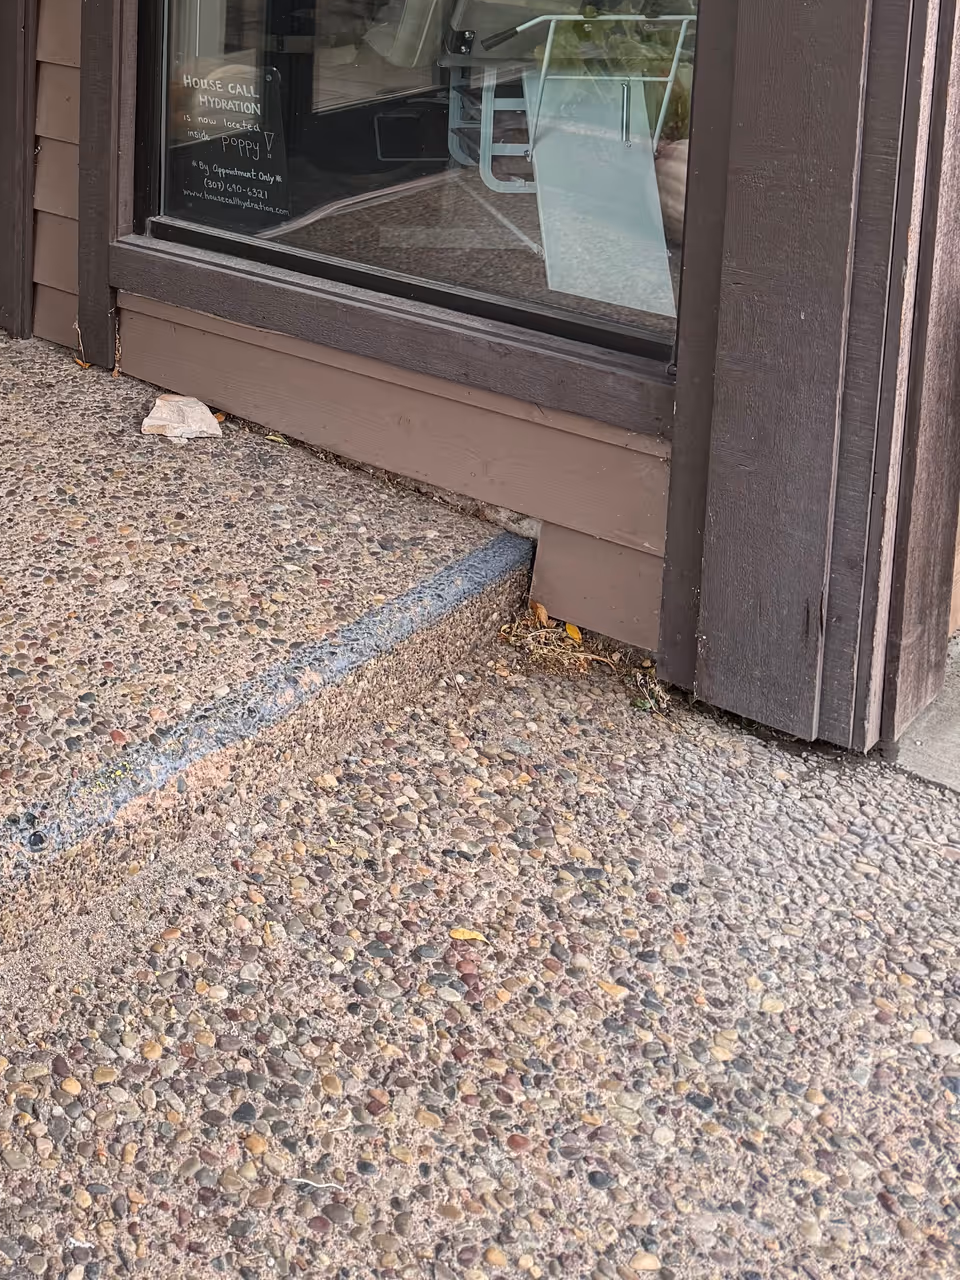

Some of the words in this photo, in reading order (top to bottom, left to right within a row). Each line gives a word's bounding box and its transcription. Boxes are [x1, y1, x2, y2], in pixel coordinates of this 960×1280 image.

[183, 74, 224, 92] HOUSE
[228, 83, 260, 98] CALL
[199, 94, 261, 116] HYDRATION
[183, 114, 191, 122] is
[198, 116, 217, 125] now
[223, 118, 261, 132] located
[187, 129, 211, 141] inside
[203, 177, 225, 192] (307)
[226, 183, 269, 199] 690-6321
